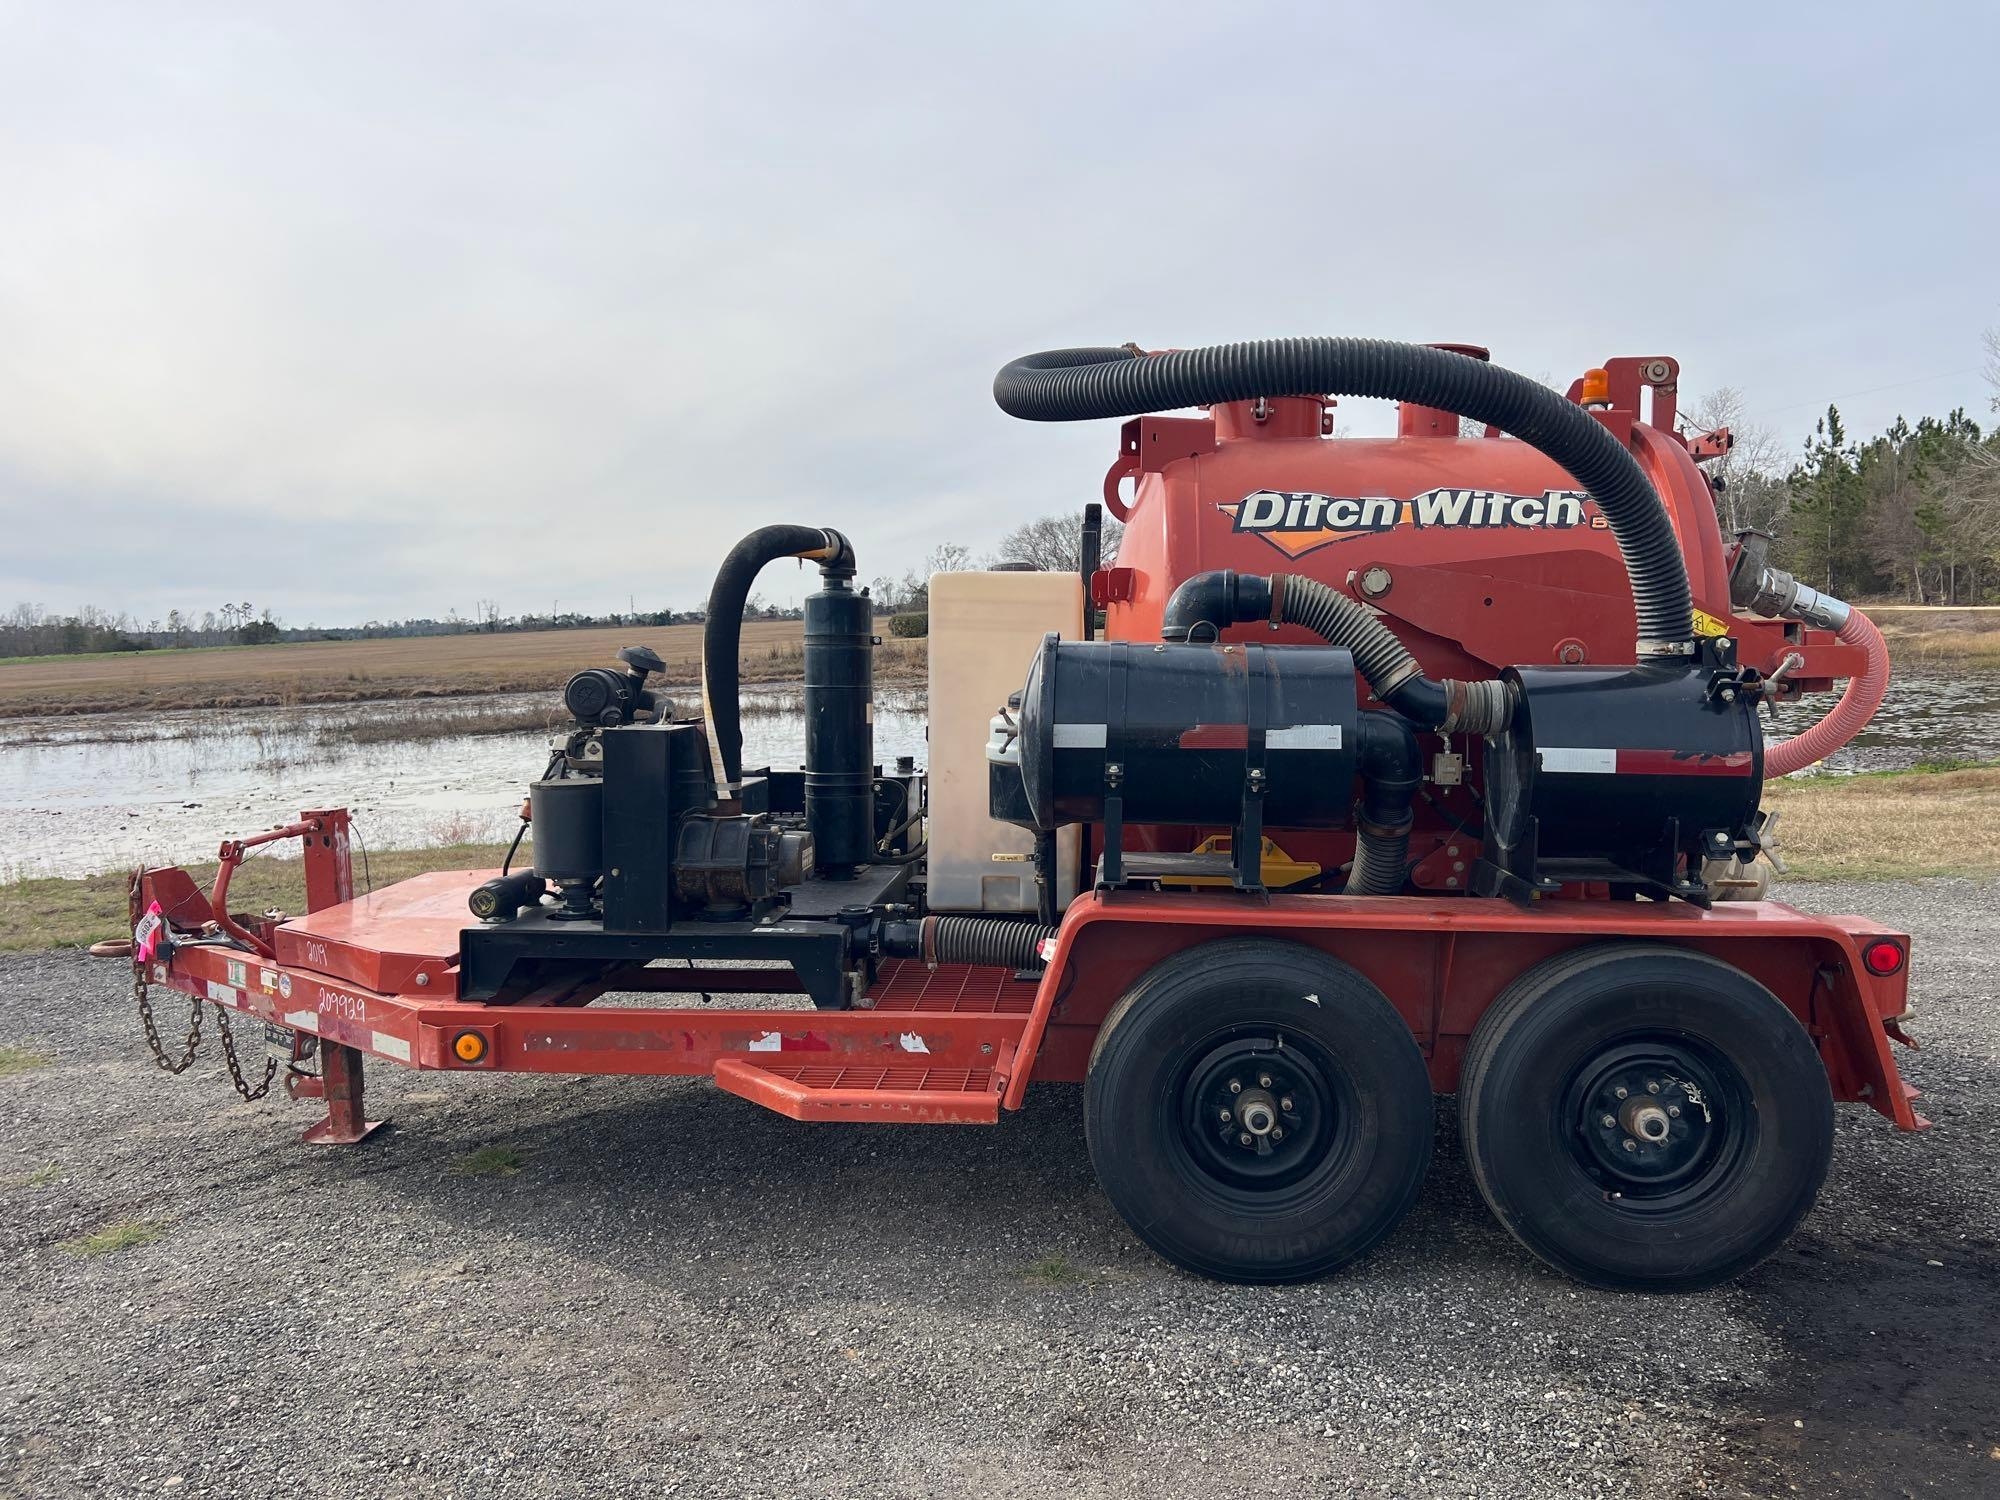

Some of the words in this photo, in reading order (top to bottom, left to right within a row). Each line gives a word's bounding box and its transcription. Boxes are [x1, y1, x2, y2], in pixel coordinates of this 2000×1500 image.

[1416, 491, 1581, 525] Witch
[306, 940, 328, 967] 2019
[318, 986, 366, 1023] 209929
